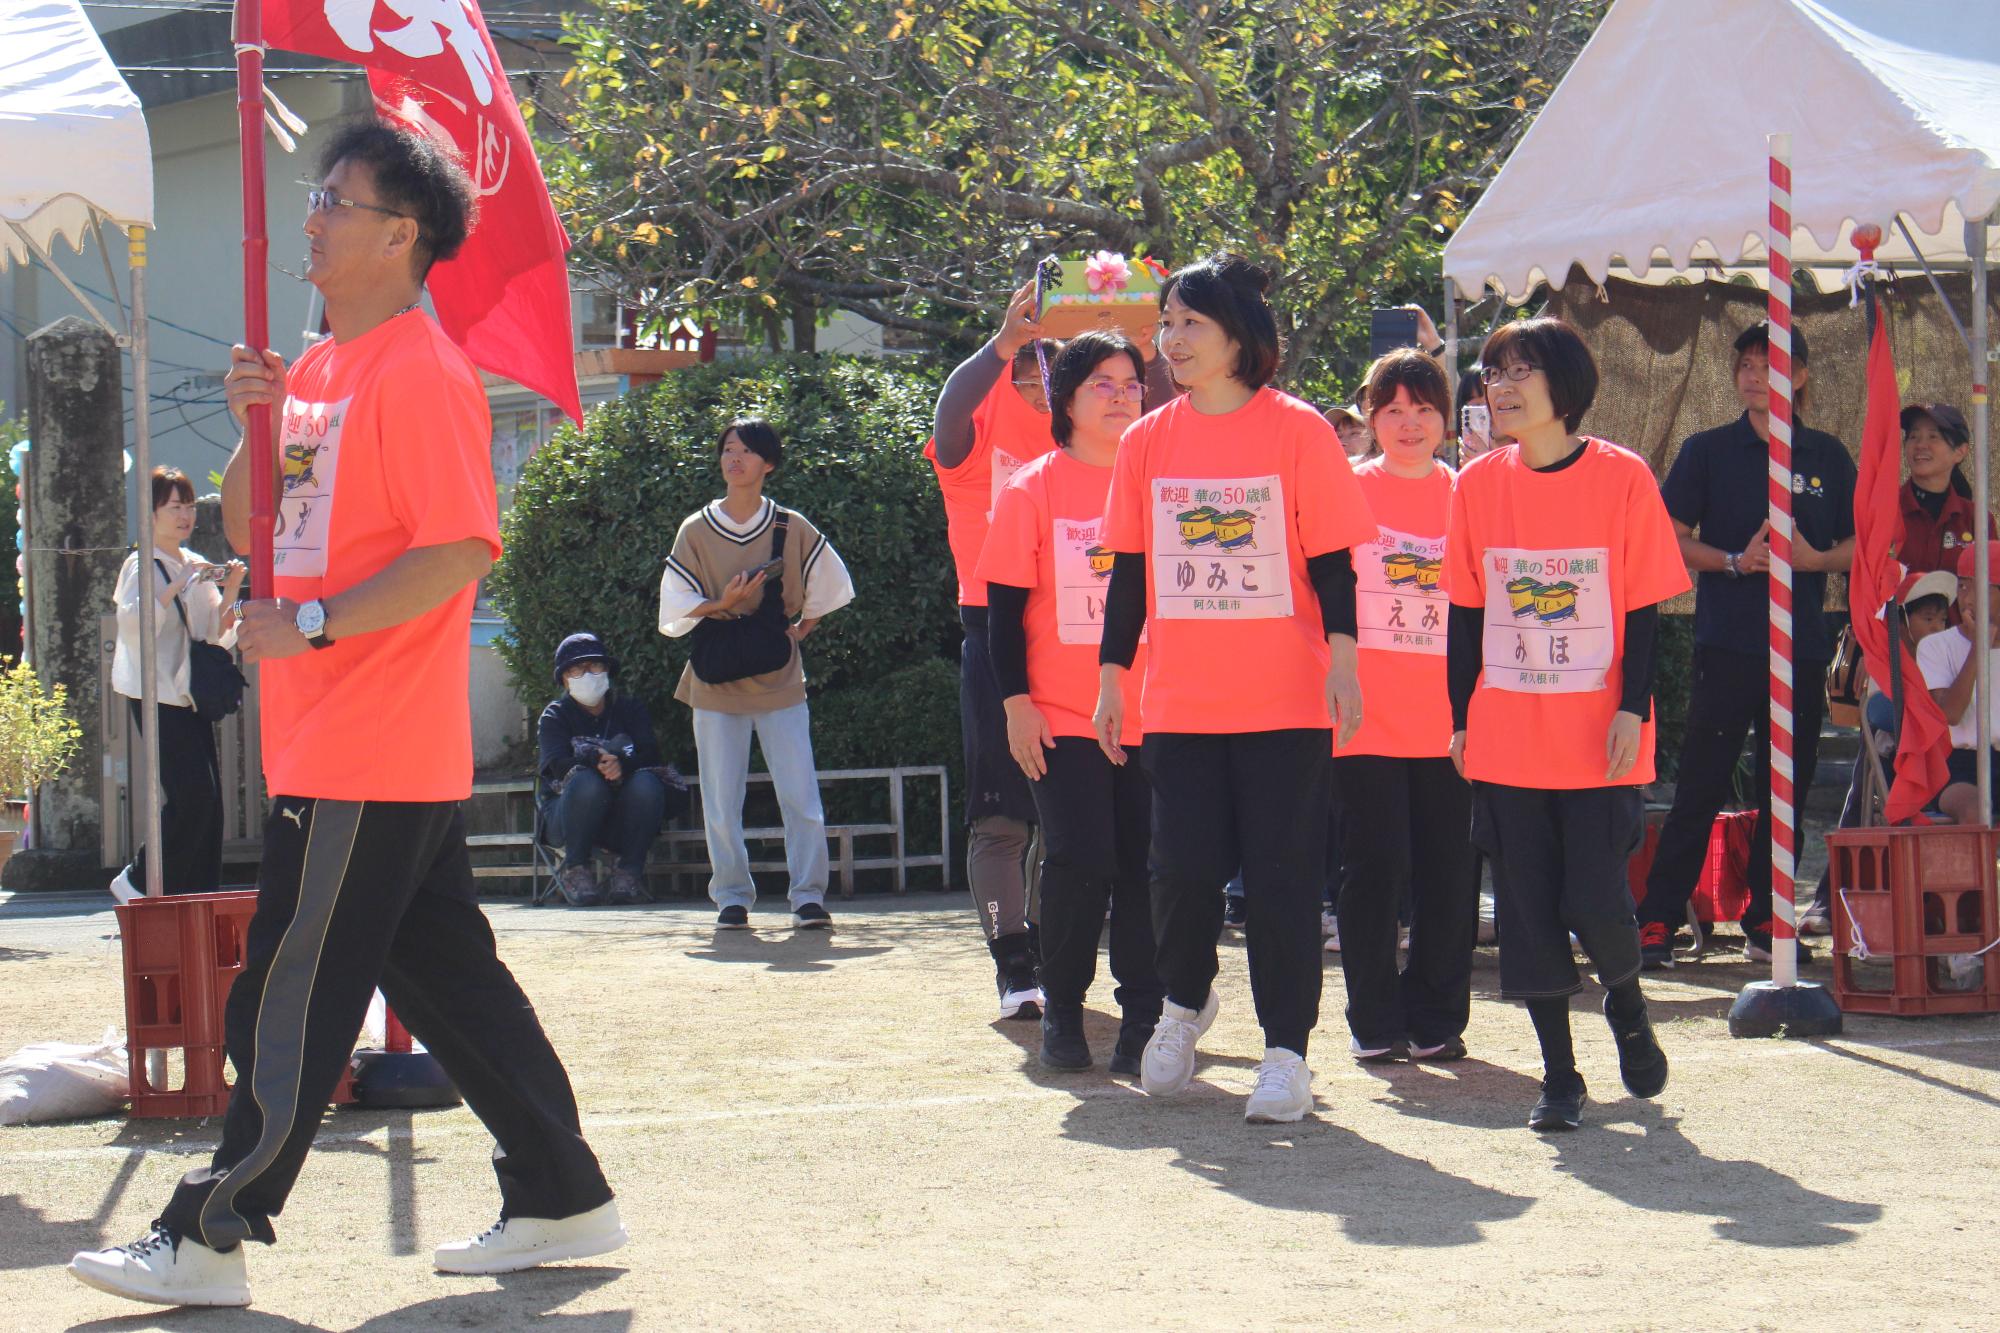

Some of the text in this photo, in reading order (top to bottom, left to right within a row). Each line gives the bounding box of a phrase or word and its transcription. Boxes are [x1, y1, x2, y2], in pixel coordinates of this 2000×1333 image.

[1160, 486, 1272, 505] 歓迎 華の50歳組
[1066, 525, 1097, 542] 歓迎
[1176, 560, 1259, 593] ゆみこ
[1513, 557, 1600, 577] 華の50歳組
[1193, 599, 1241, 611] 阿久根市
[1388, 598, 1440, 631] えみ
[1515, 632, 1570, 665] みほ
[1519, 671, 1560, 685] 阿久根市
